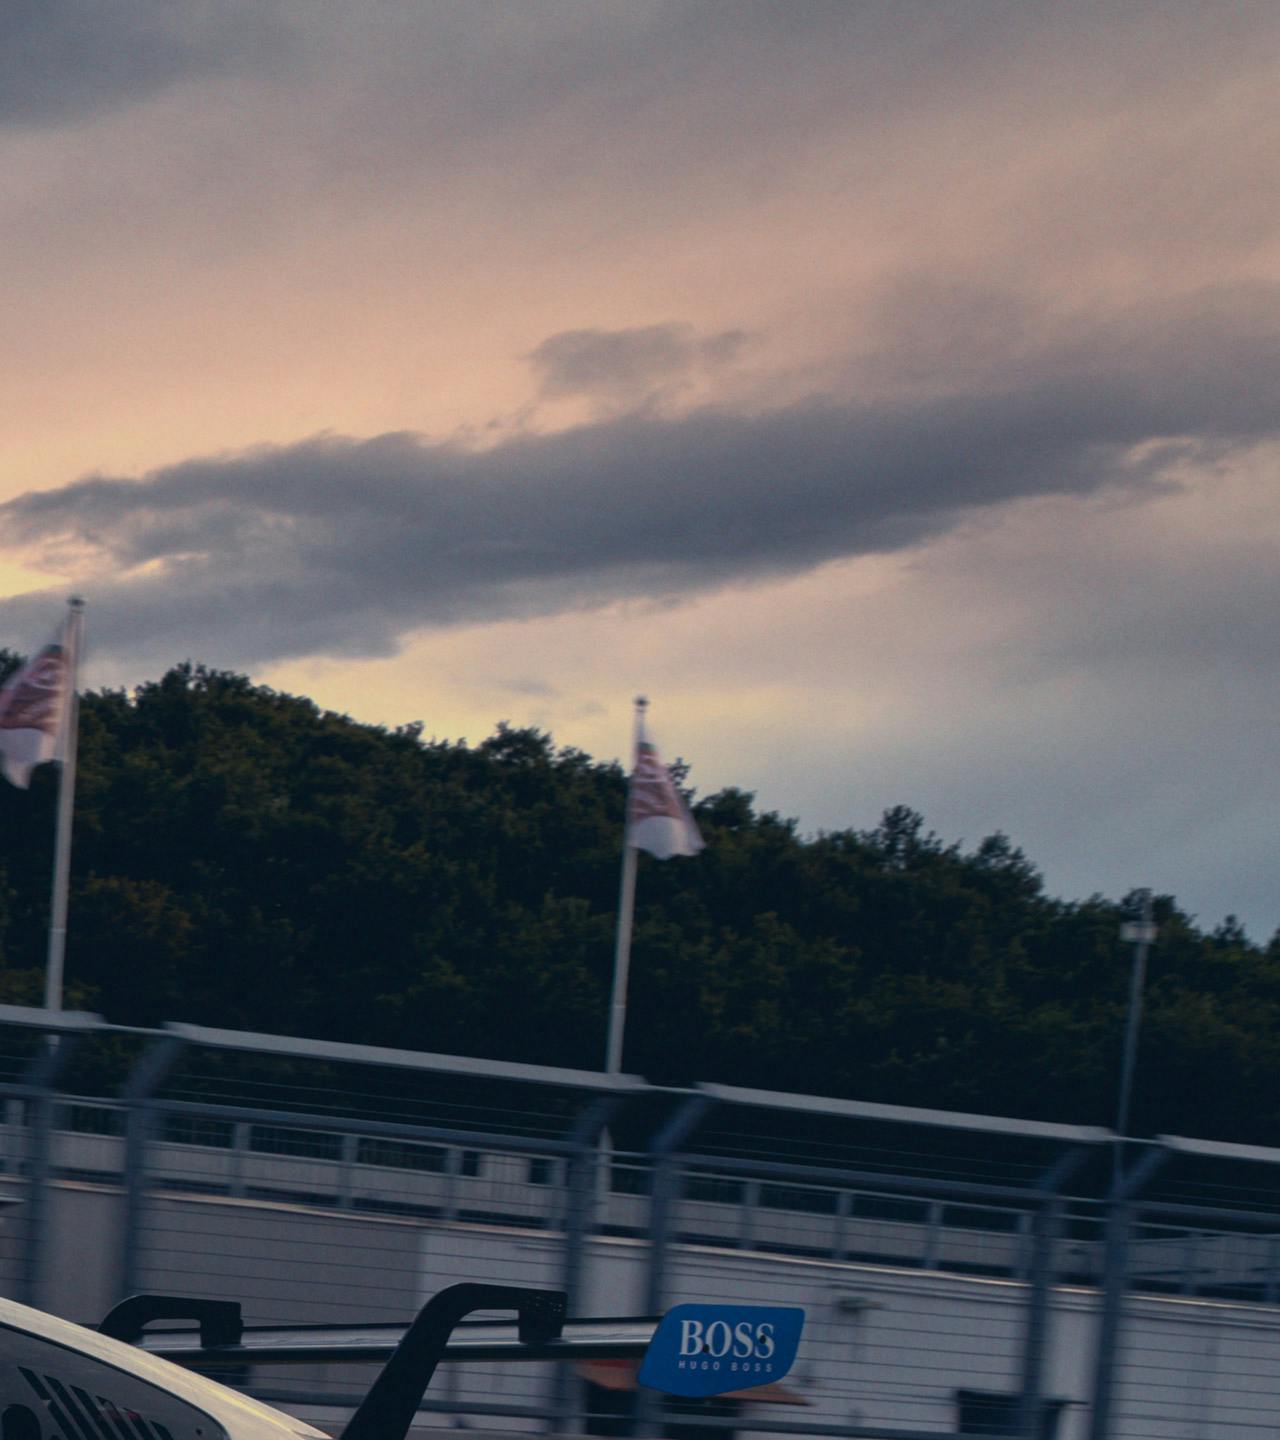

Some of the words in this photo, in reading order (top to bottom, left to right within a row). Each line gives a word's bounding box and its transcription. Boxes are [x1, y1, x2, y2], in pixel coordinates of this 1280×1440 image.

[678, 1319, 776, 1359] BOSS
[678, 1360, 721, 1371] HUGO
[730, 1362, 773, 1373] BOSS
